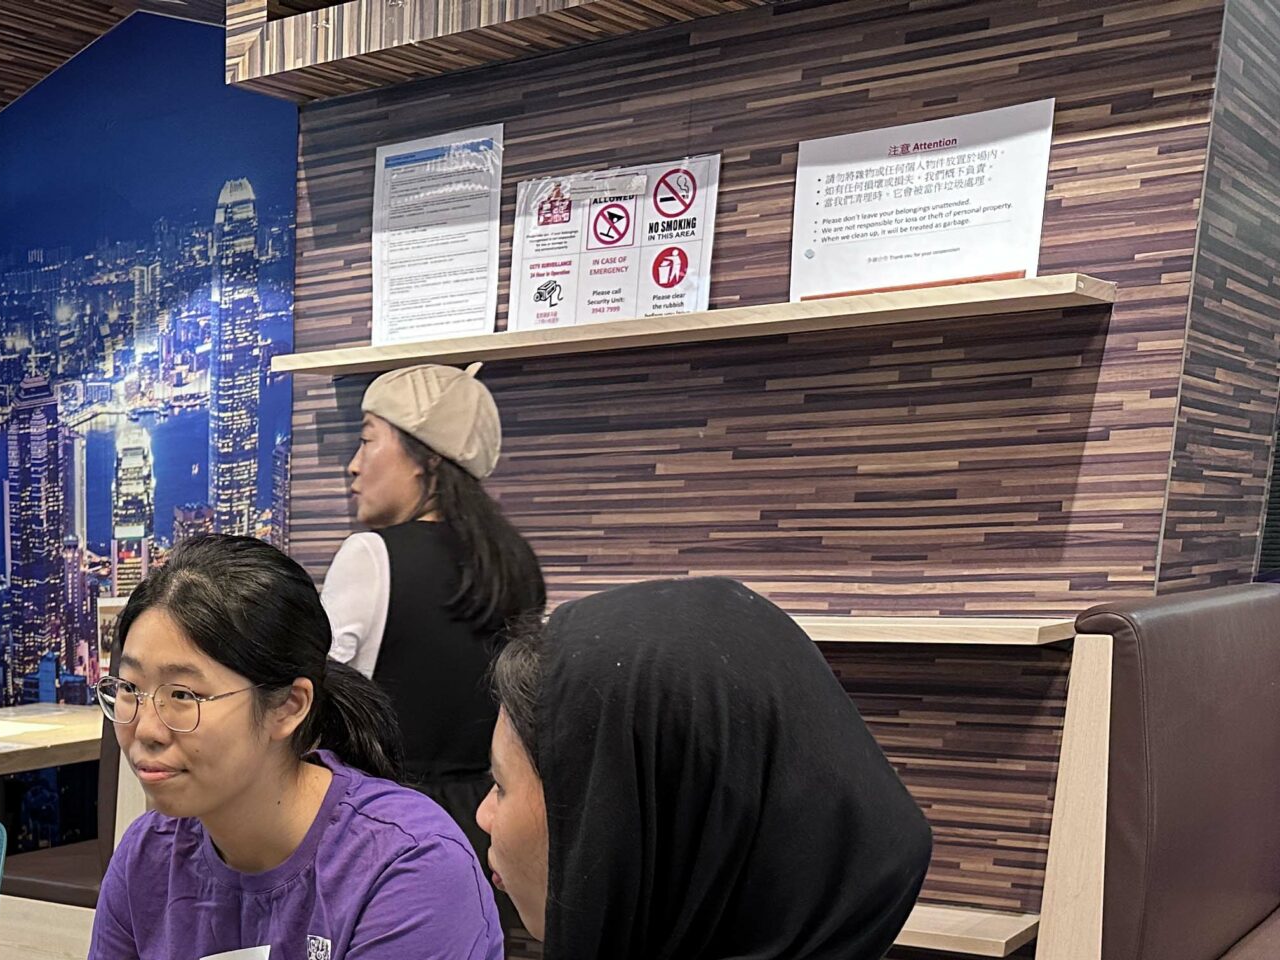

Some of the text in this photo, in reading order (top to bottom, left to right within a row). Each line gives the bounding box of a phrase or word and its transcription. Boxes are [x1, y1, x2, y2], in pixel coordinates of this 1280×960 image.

[888, 138, 957, 156] 注意 Attention
[592, 194, 635, 205] ALLOWED
[822, 217, 842, 225] Please
[879, 210, 894, 218] your
[895, 205, 930, 215] belongings
[856, 220, 893, 230] responsible
[928, 212, 943, 220] theft
[953, 206, 981, 217] personal
[982, 202, 1012, 213] property.
[648, 217, 697, 234] NO SMOKING
[821, 235, 839, 243] When
[909, 223, 934, 231] treated
[943, 218, 970, 228] garbage.
[657, 232, 673, 240] THIS
[675, 230, 695, 238] AREA
[589, 266, 629, 275] EMERGENCY
[652, 291, 686, 301] Please clear
[663, 301, 684, 309] rubbish
